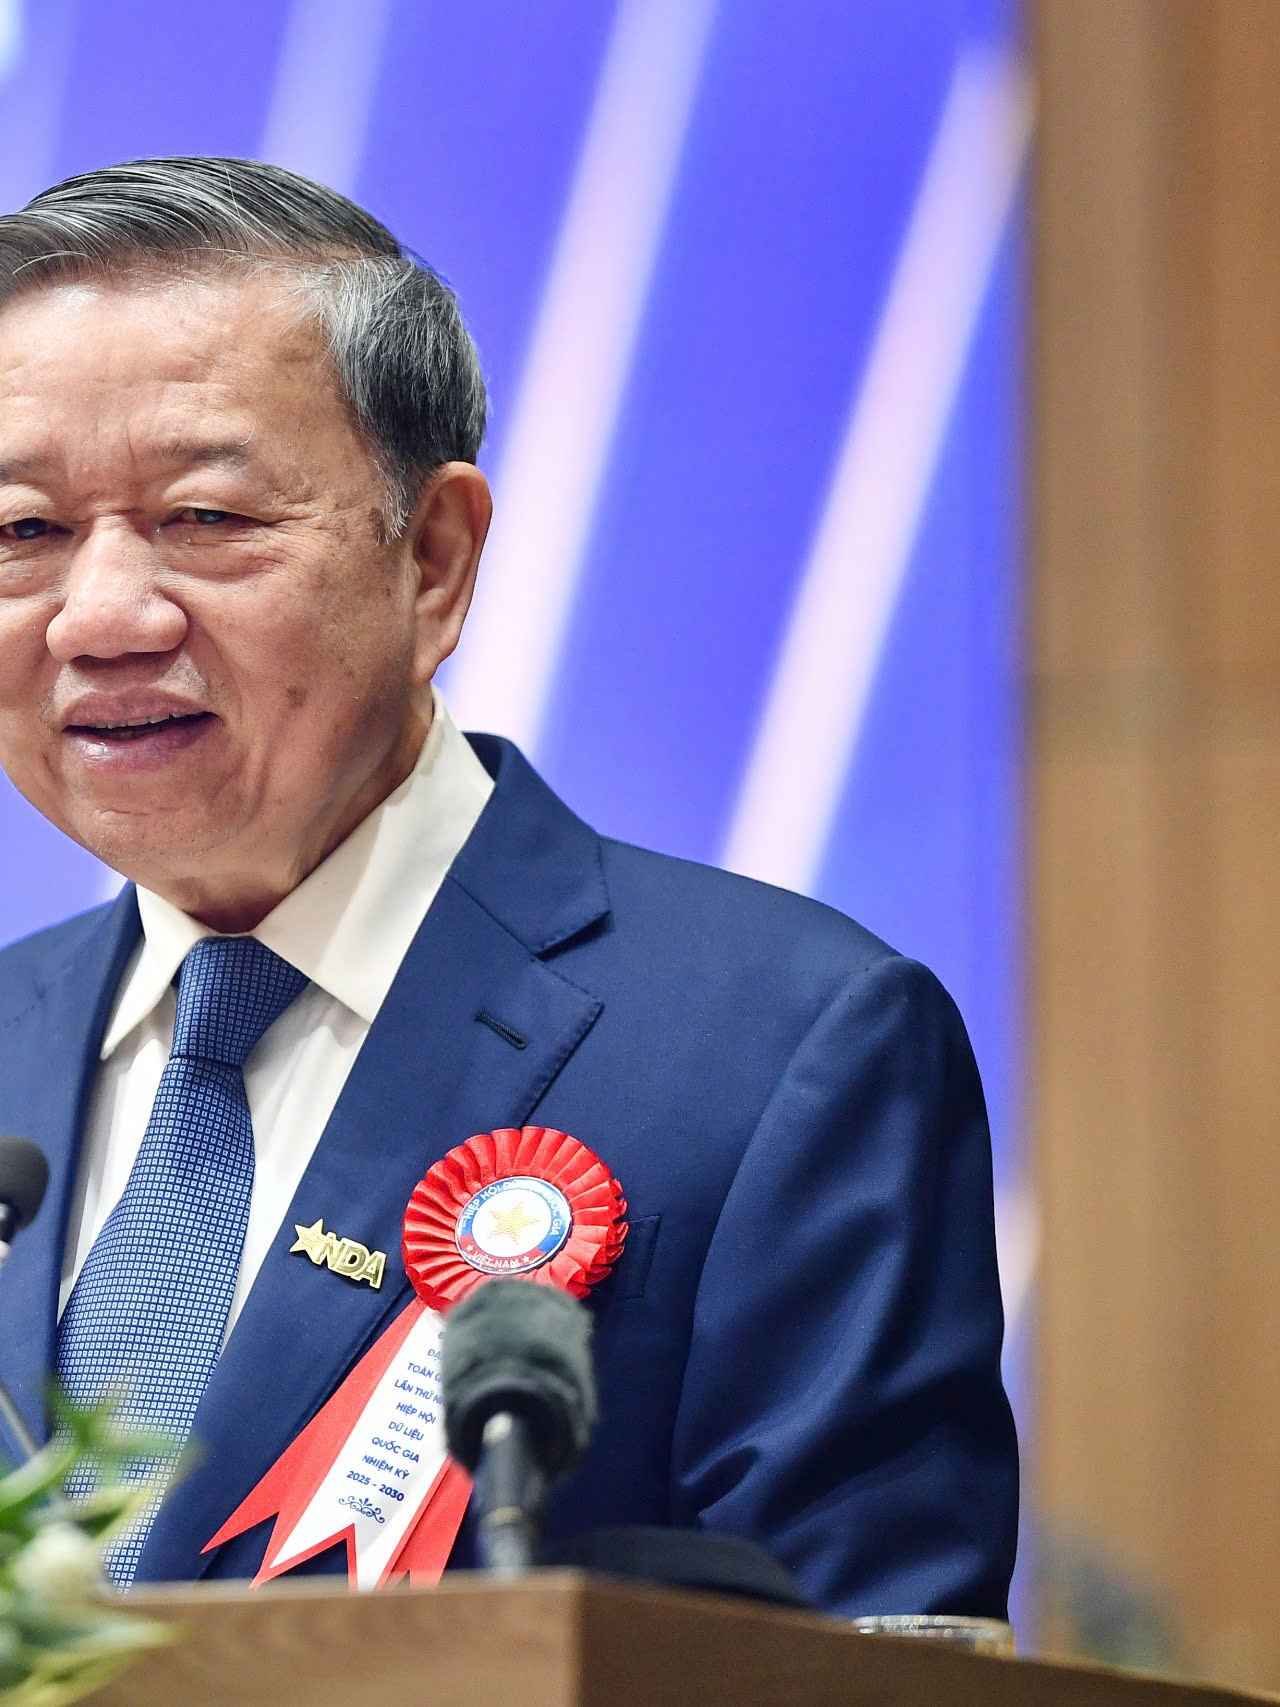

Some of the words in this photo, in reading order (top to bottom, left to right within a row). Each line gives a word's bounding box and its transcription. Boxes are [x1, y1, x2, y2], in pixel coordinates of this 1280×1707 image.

[315, 1231, 387, 1289] NDA
[396, 1402, 418, 1415] HIỆP
[417, 1410, 437, 1424] HỘI
[403, 1427, 424, 1441] LIỆU
[371, 1436, 402, 1454] QUỐC
[402, 1449, 420, 1463] GIA
[362, 1454, 394, 1473] NHIỆM
[346, 1470, 371, 1485] 2025
[378, 1483, 405, 1501] 2030
